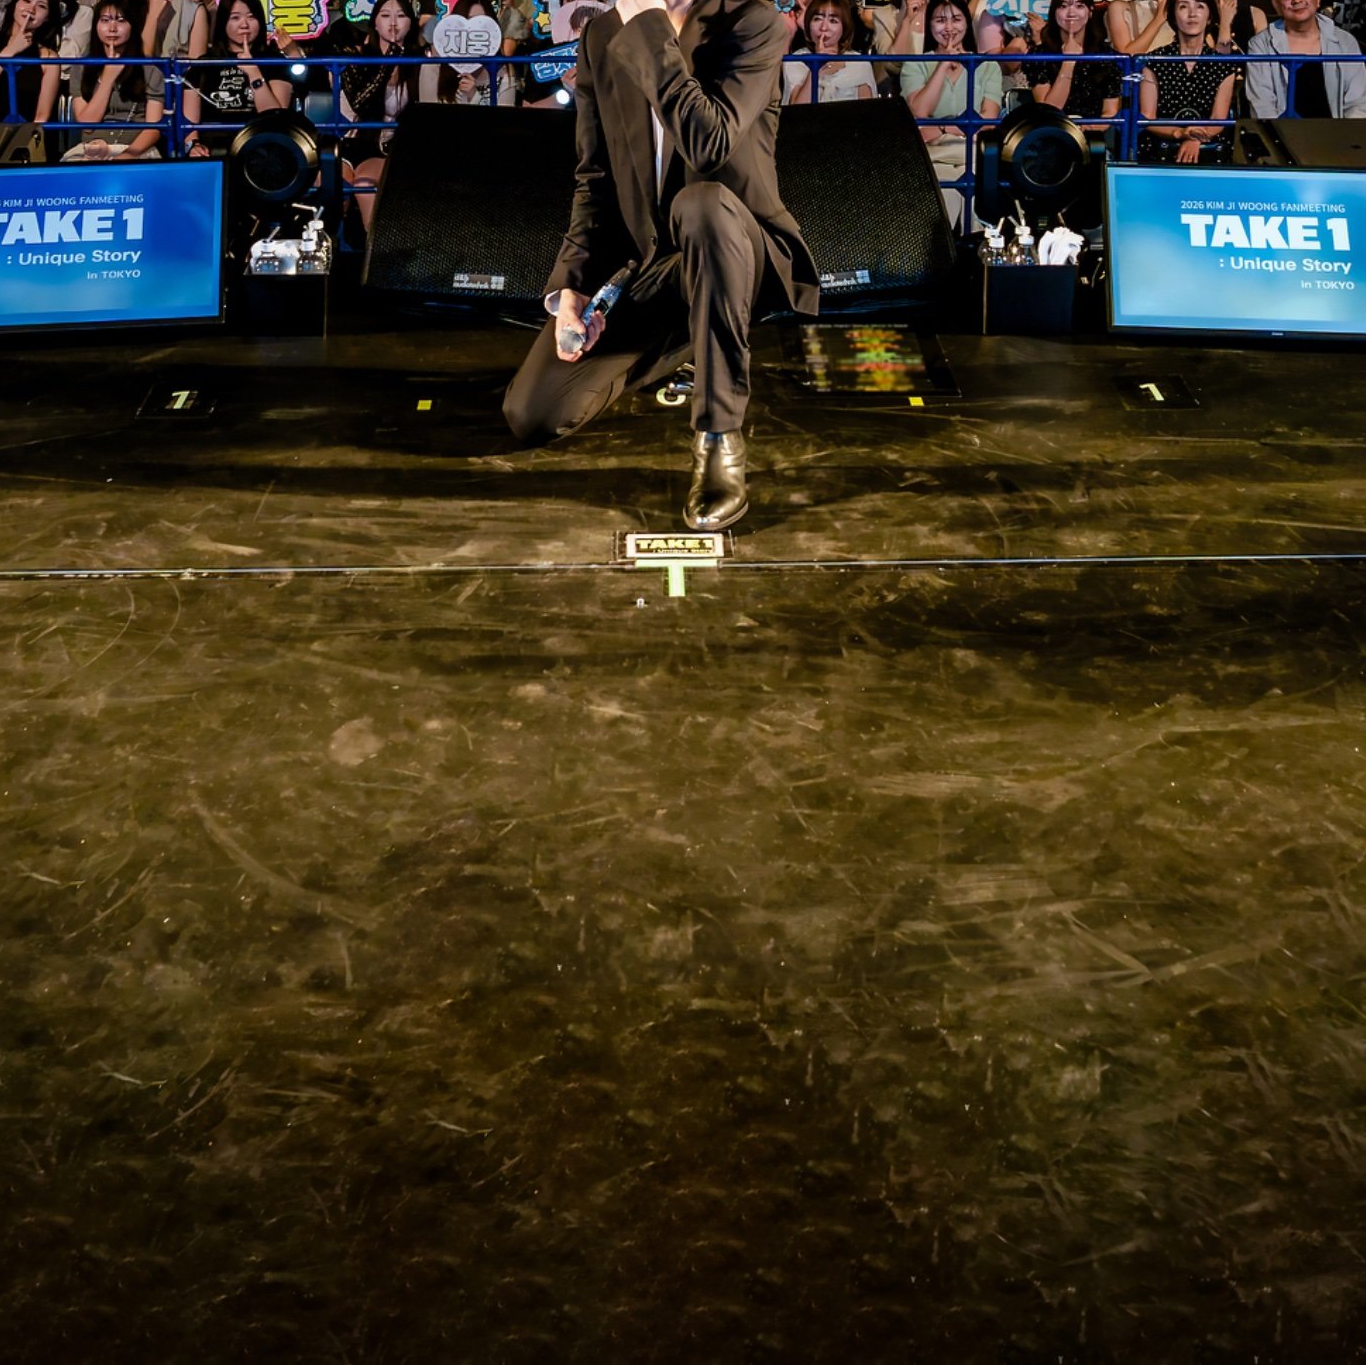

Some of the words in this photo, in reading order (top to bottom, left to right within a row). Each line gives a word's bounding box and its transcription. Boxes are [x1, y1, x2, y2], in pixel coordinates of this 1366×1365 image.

[444, 29, 491, 56] 지웅
[3, 199, 22, 208] KIM
[24, 199, 33, 208] JI
[36, 197, 76, 206] WOONG
[79, 194, 144, 205] FANMEETING
[1181, 200, 1204, 210] 2026
[1205, 201, 1224, 210] KIM
[1227, 202, 1235, 211] JI
[1238, 202, 1278, 212] WOONG
[1281, 202, 1346, 213] FANMEETING
[122, 207, 144, 240] 1
[1180, 213, 1321, 250] TAKE
[1327, 217, 1350, 251] 1
[19, 251, 86, 266] Unique
[91, 250, 142, 264] Story
[1230, 256, 1296, 272] Unique
[1302, 258, 1352, 275] Story
[102, 269, 141, 279] TOKYO
[1316, 281, 1355, 291] TOKYO
[172, 390, 191, 409] 1
[1139, 383, 1165, 401] 1
